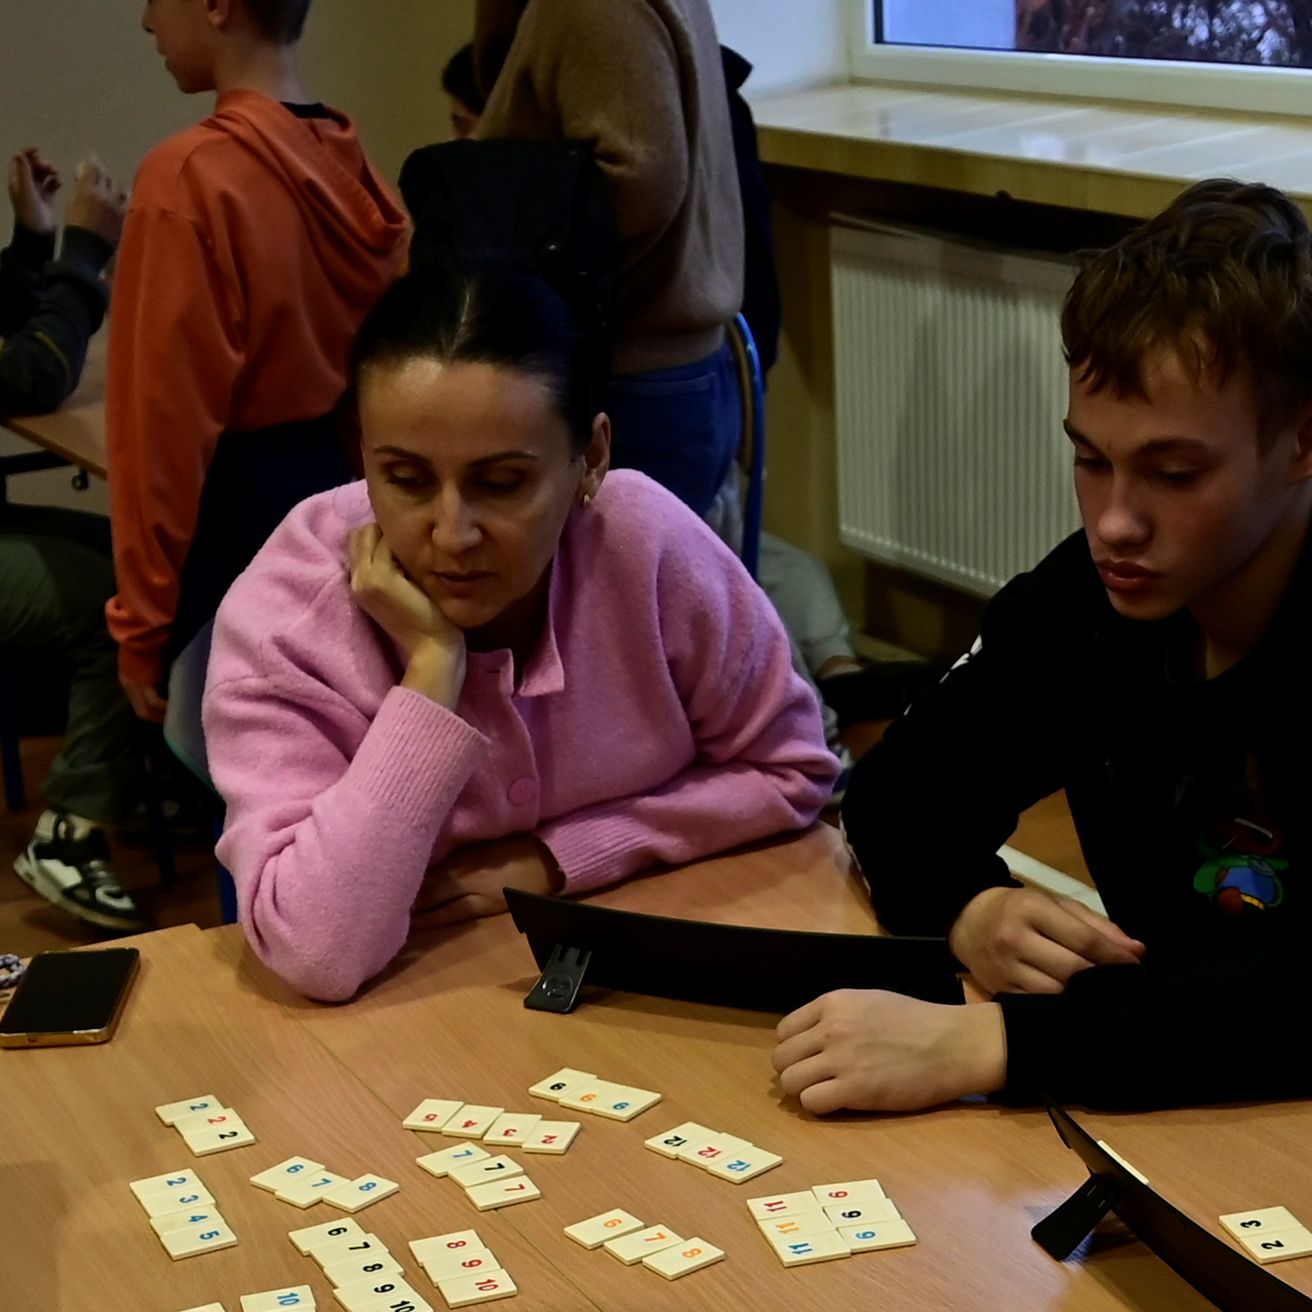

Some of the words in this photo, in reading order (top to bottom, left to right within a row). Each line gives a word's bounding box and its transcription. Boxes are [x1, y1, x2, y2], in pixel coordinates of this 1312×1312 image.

[549, 1082, 567, 1091] 9
[579, 1093, 597, 1103] 9
[189, 1102, 209, 1112] 2
[612, 1101, 630, 1111] 9
[206, 1115, 227, 1125] 2
[422, 1113, 439, 1122] 5
[461, 1119, 478, 1129] 4
[218, 1131, 239, 1140] 2
[502, 1128, 518, 1137] 3
[541, 1134, 558, 1145] 2
[663, 1135, 688, 1147] 12
[452, 1149, 474, 1159] 7
[697, 1146, 722, 1159] 12
[285, 1164, 305, 1174] 6
[484, 1162, 506, 1172] 7
[726, 1159, 752, 1172] 12
[166, 1176, 187, 1187] 2
[311, 1177, 332, 1188] 7
[358, 1181, 378, 1192] 8
[504, 1183, 526, 1192] 7
[178, 1194, 200, 1204] 3
[828, 1190, 849, 1199] 6
[763, 1200, 788, 1213] 11
[188, 1215, 209, 1223] 4
[841, 1210, 862, 1219] 6
[603, 1218, 623, 1229] 6
[775, 1221, 800, 1235] 11
[1240, 1220, 1262, 1229] 3
[199, 1230, 220, 1241] 5
[327, 1227, 348, 1236] 6
[855, 1230, 877, 1240] 6
[644, 1232, 667, 1242] 7
[348, 1241, 371, 1251] 7
[446, 1240, 467, 1249] 8
[788, 1242, 813, 1255] 11
[1260, 1240, 1284, 1250] 2
[681, 1247, 703, 1259] 8
[362, 1263, 384, 1273] 8
[461, 1259, 483, 1268] 9
[373, 1284, 395, 1293] 9
[474, 1278, 499, 1292] 10
[276, 1292, 301, 1306] 10
